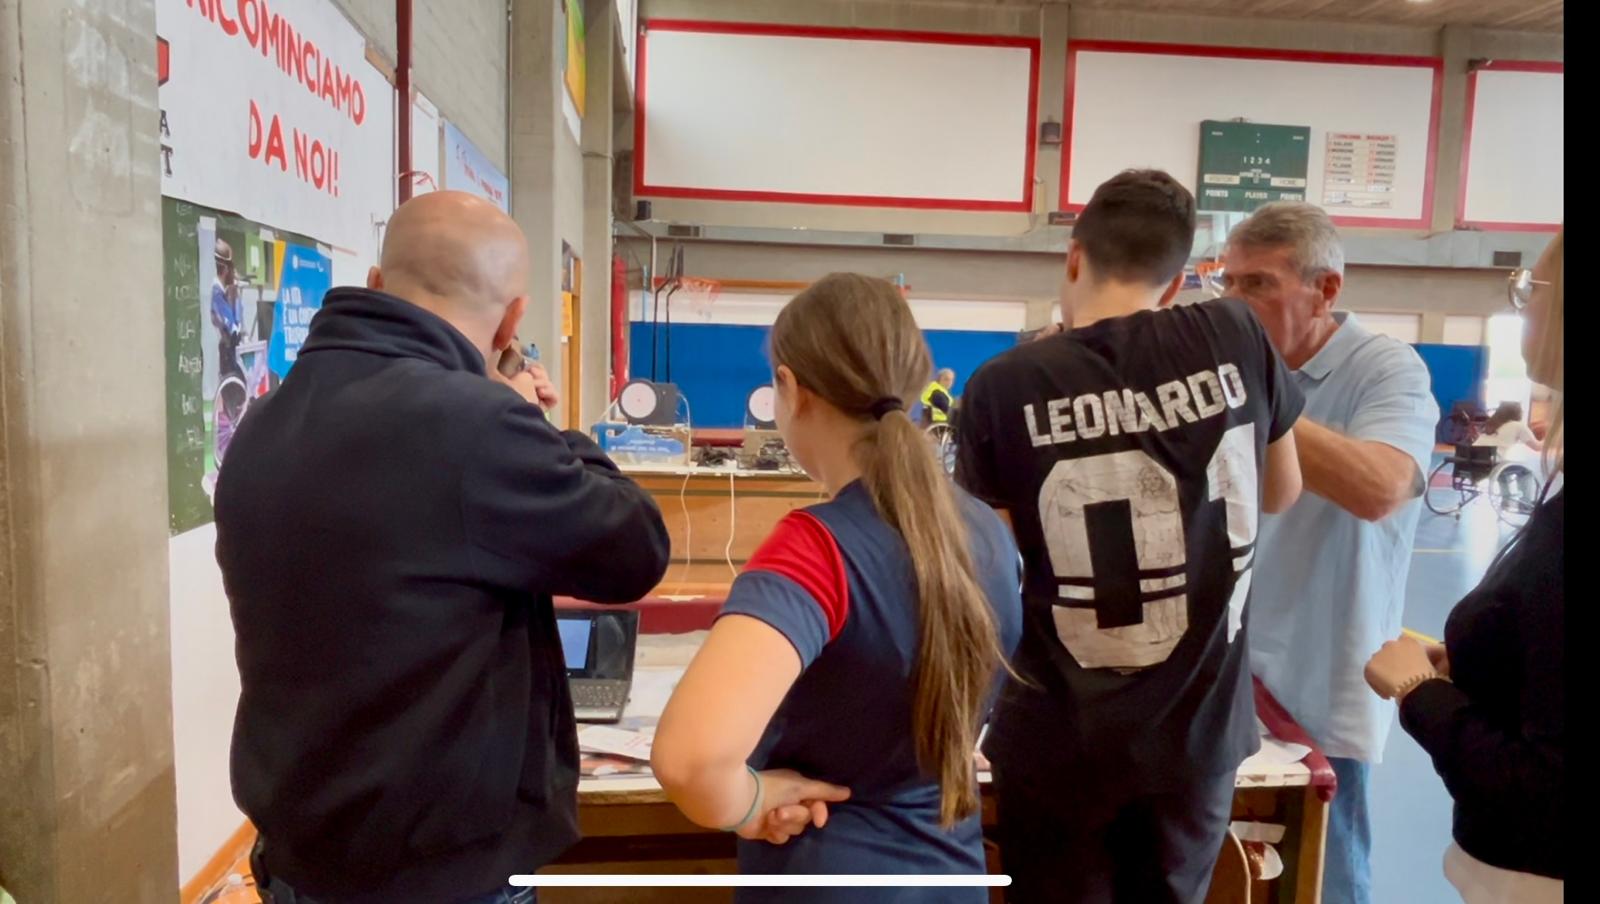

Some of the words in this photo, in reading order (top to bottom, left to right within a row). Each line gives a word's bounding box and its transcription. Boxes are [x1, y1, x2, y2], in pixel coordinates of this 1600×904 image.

[186, 0, 365, 126] COMINCIAMO
[249, 98, 287, 172] DA
[293, 127, 338, 198] NOI!
[1205, 188, 1229, 198] POINTS
[1244, 191, 1269, 200] PLAYER
[1280, 192, 1303, 201] POINTS
[1023, 362, 1248, 448] LEONARDO
[1038, 422, 1258, 669] 01
